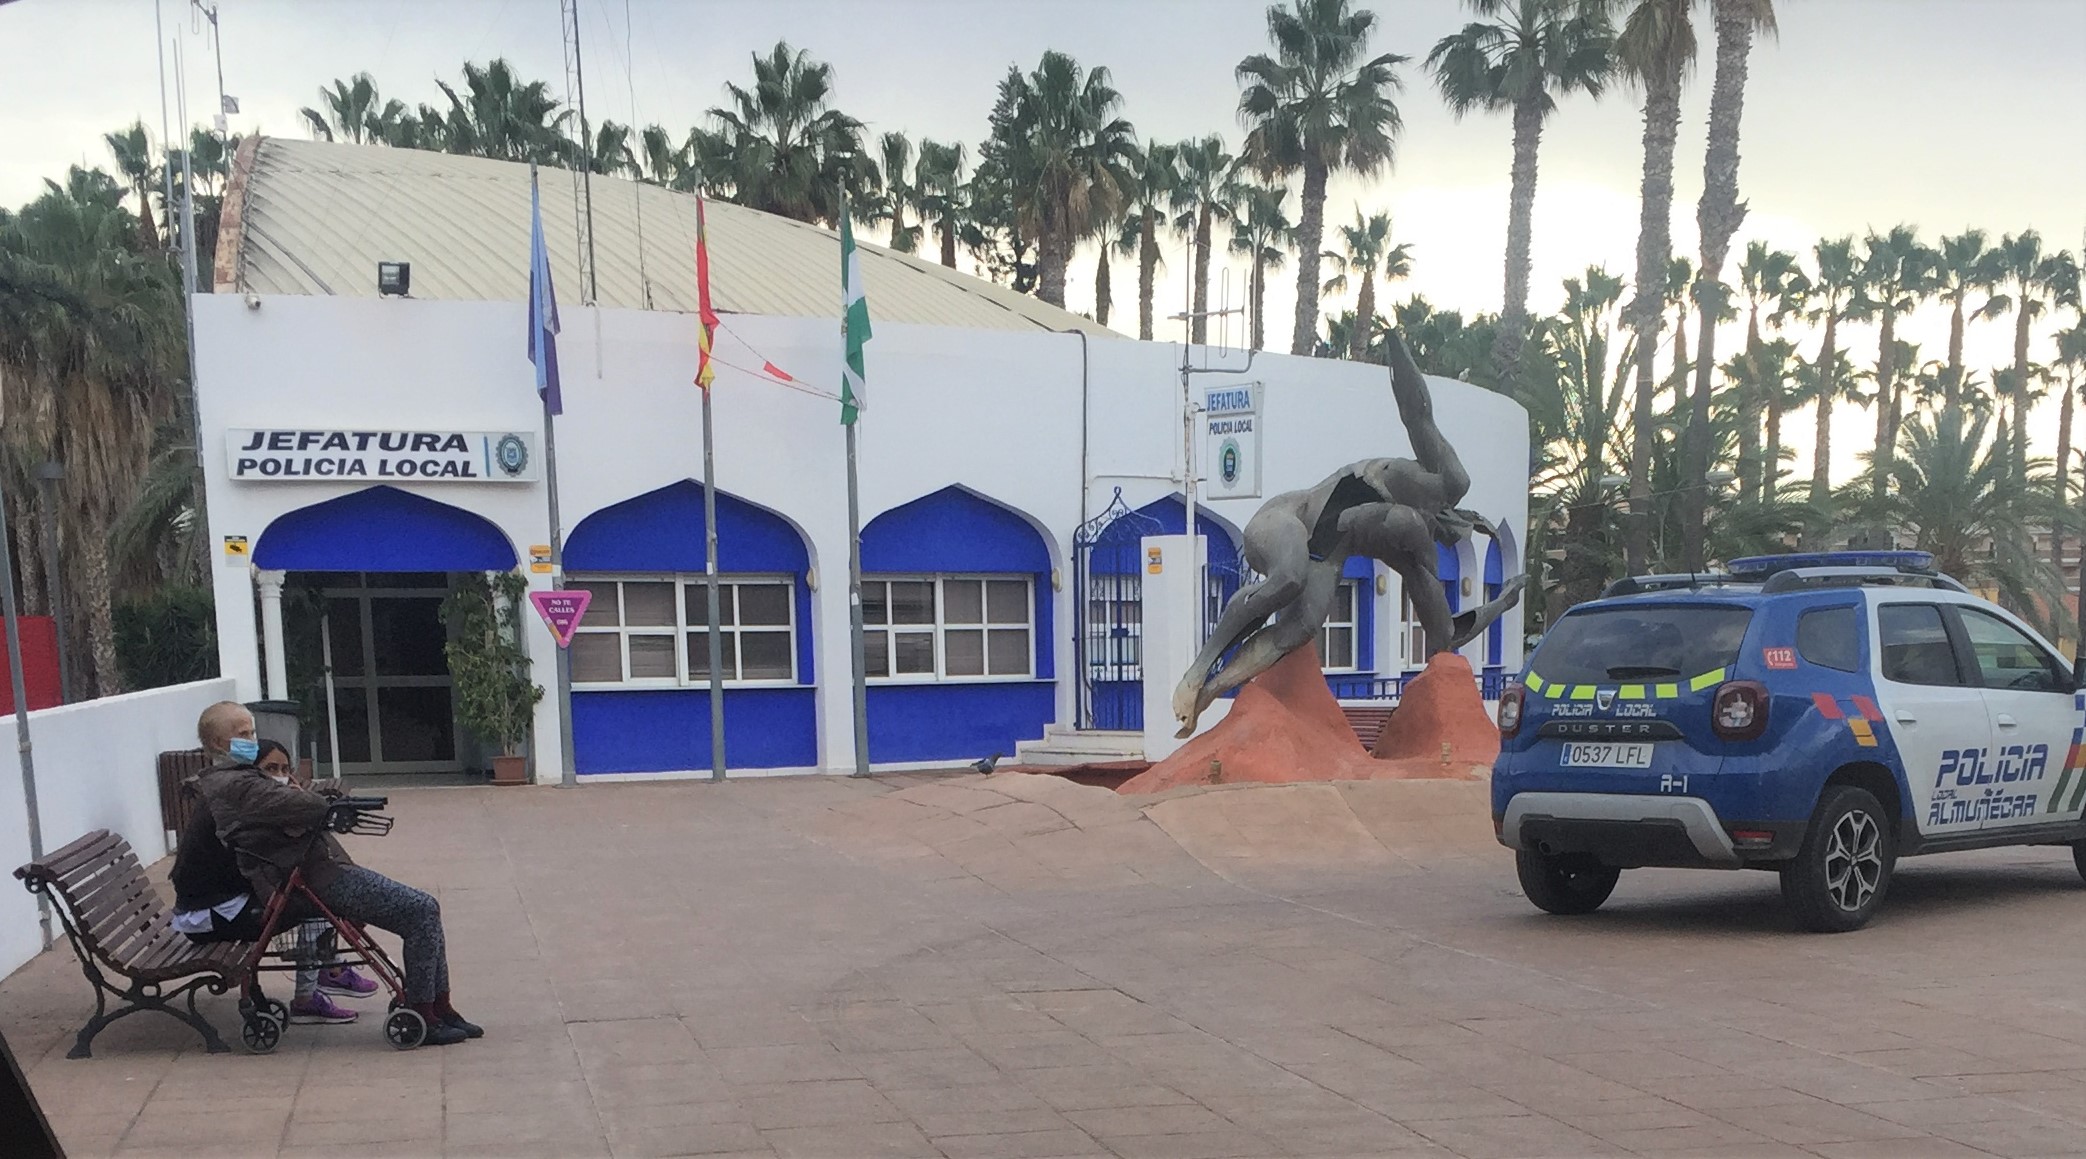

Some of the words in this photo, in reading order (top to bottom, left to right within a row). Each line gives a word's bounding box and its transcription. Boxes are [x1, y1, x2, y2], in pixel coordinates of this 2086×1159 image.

[1207, 390, 1250, 412] JEFATURA
[1209, 420, 1233, 435] POLICIA
[1234, 419, 1253, 434] LOCAL
[241, 431, 469, 453] JEFATURA
[236, 458, 367, 476] POLICIA
[377, 459, 478, 478] LOCAL
[1772, 650, 1792, 662] 112
[1551, 703, 1593, 716] POLICIA
[1615, 703, 1657, 717] LOCAL
[1558, 724, 1651, 734] DUSTER
[1572, 745, 1612, 764] 0537
[1615, 746, 1646, 765] LFL
[1935, 743, 2049, 788] POLICIA
[1930, 789, 1958, 801] LOCAL
